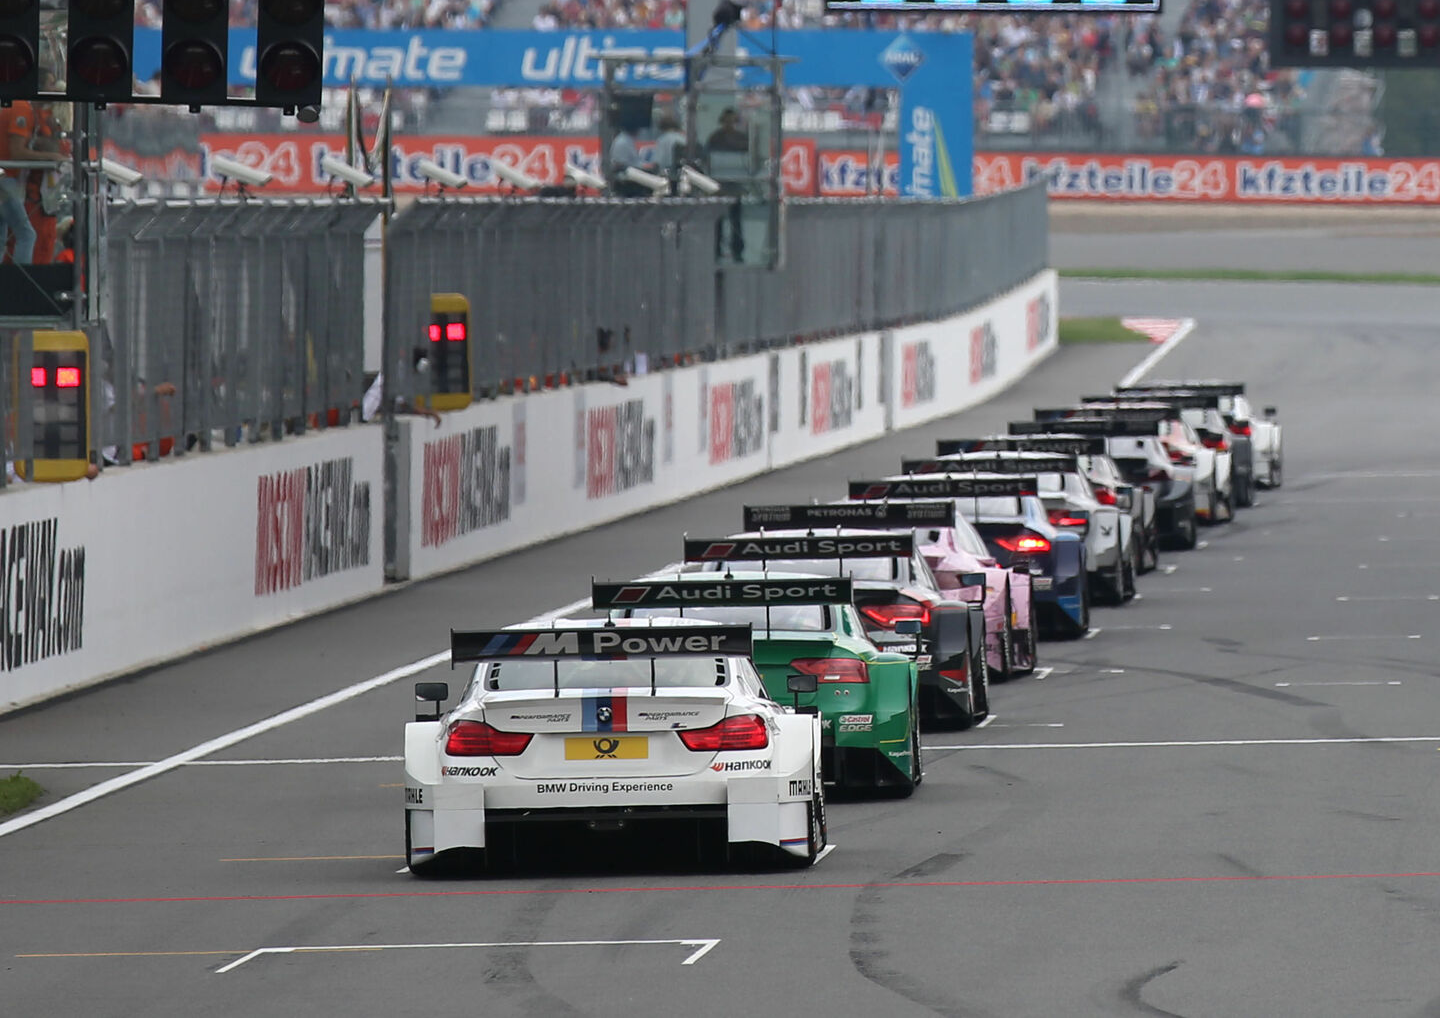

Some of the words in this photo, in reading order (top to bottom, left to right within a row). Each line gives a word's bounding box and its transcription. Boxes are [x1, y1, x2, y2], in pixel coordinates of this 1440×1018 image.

[895, 483, 950, 493] Audi
[959, 481, 1026, 495] Sport
[742, 540, 808, 555] Audi
[818, 539, 901, 555] Sport
[656, 584, 731, 599] Audi
[742, 584, 837, 601] Sport
[523, 632, 579, 655] M
[593, 632, 727, 654] Power
[840, 724, 872, 732] EDGE
[537, 783, 566, 793] BMW
[570, 782, 609, 796] Driving
[612, 782, 673, 795] Experience
